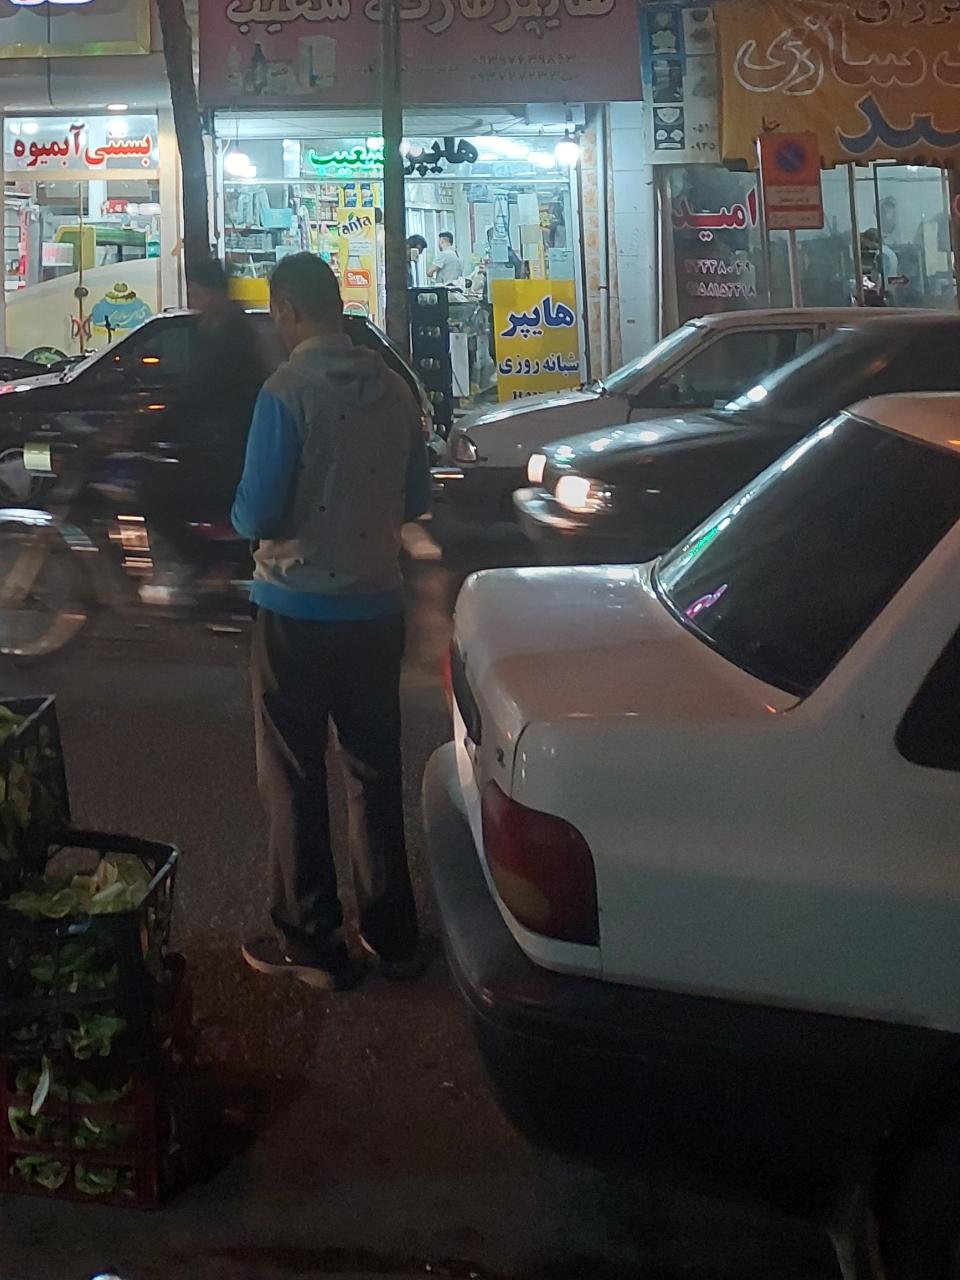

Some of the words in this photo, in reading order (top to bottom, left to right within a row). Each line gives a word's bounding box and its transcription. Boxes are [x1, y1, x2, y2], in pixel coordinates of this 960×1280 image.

[14, 124, 83, 168] آبمیوه
[85, 128, 154, 166] بستنی
[500, 294, 577, 340] هایپر
[498, 354, 541, 375] روزی
[543, 353, 581, 377] شبانه
